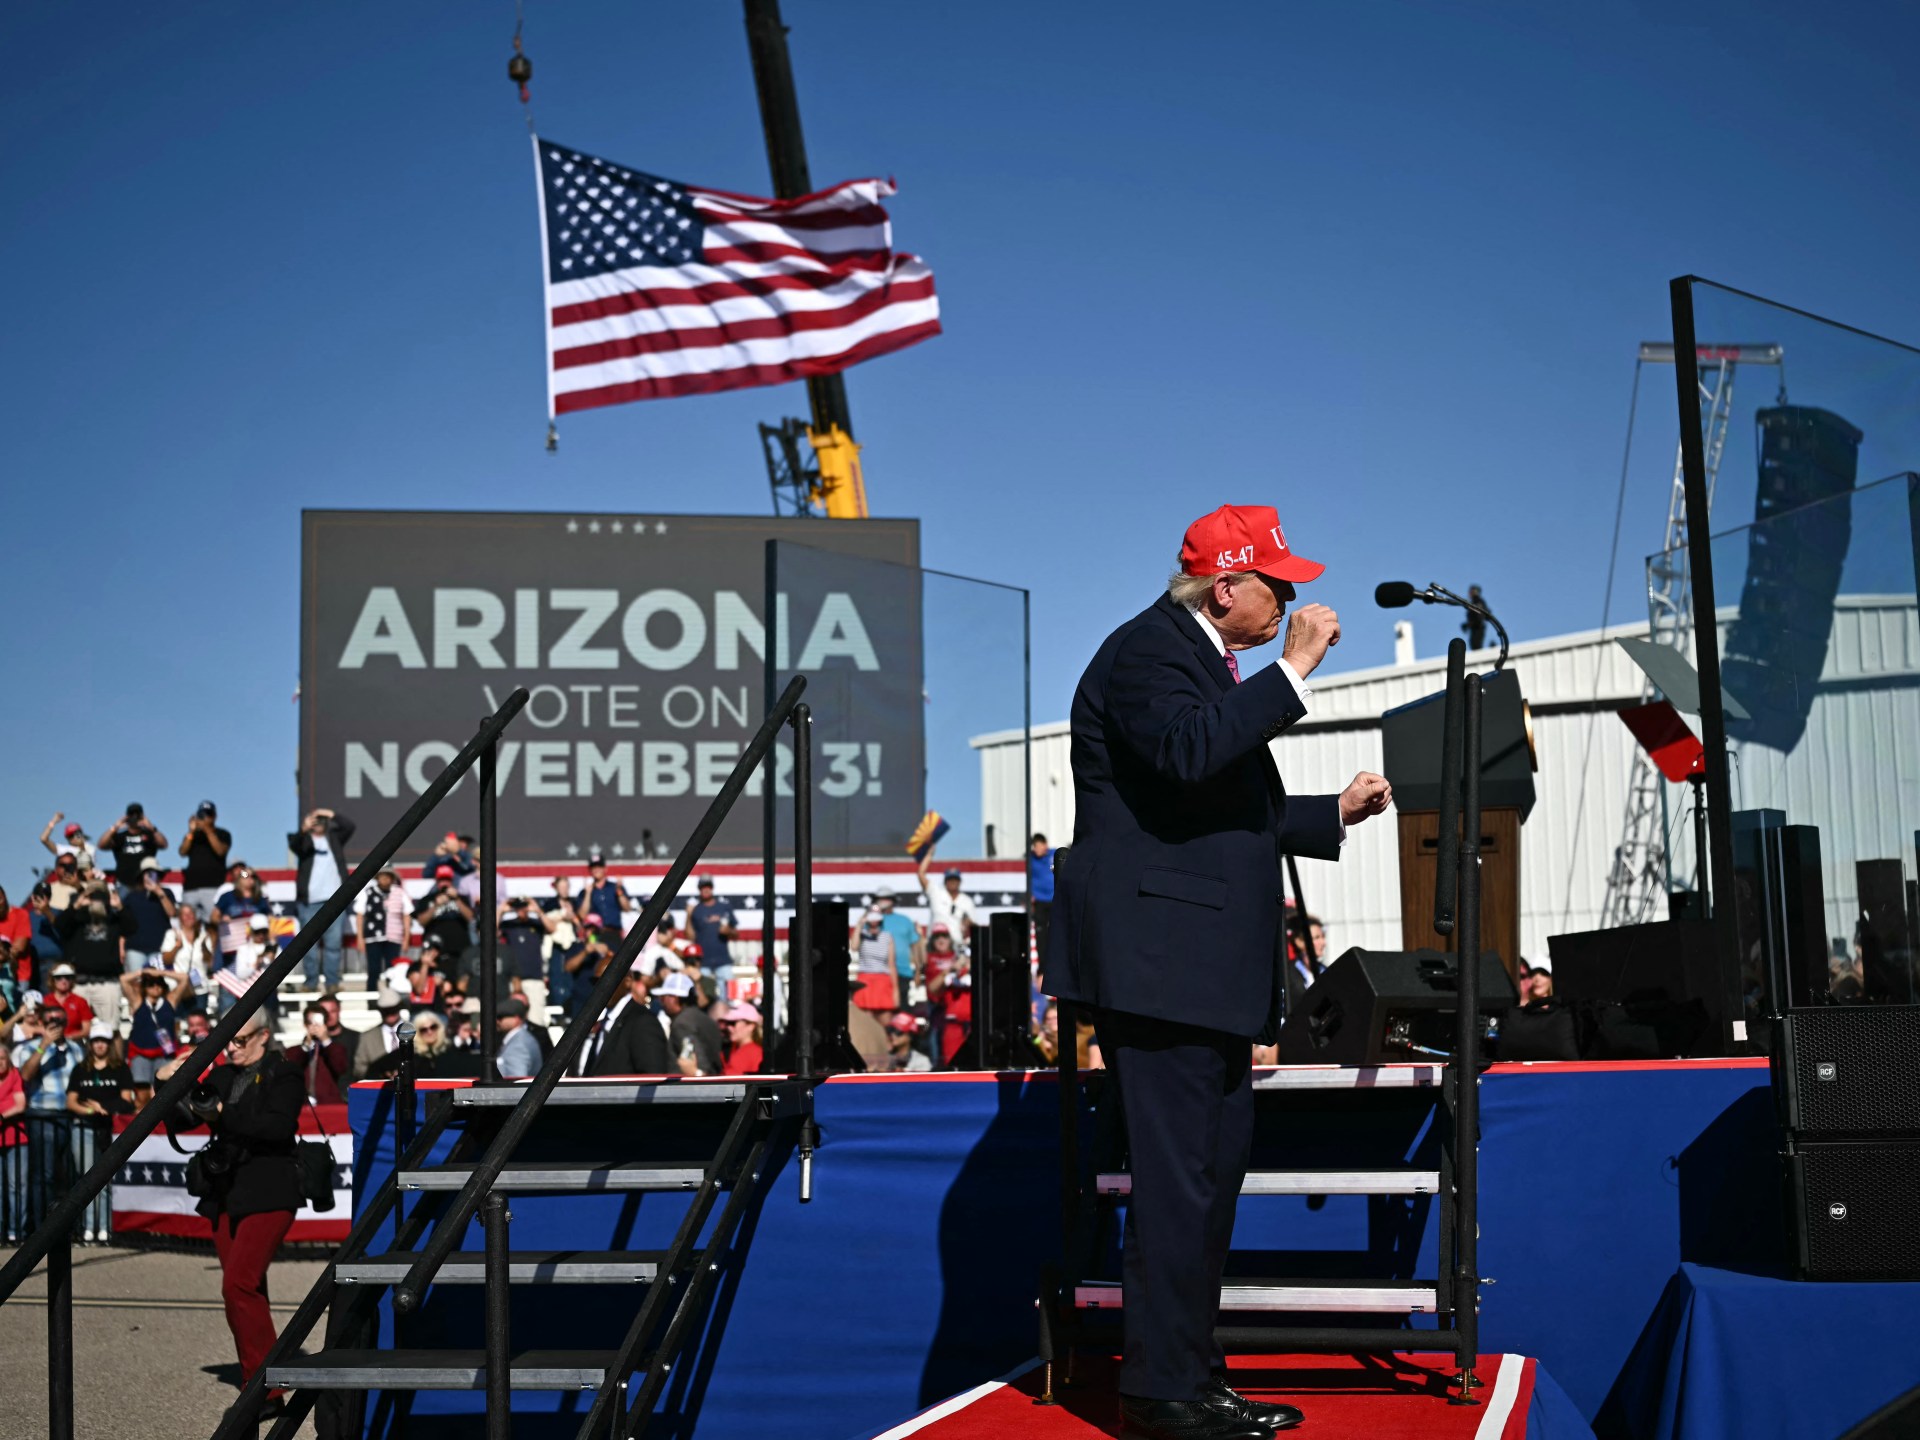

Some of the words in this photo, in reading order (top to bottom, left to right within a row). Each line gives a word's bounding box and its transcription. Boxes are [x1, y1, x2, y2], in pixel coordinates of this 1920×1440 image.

[1216, 545, 1254, 569] 45-47
[338, 587, 880, 671] ARIZONA
[662, 685, 748, 728] ON
[819, 742, 883, 798] 3!
